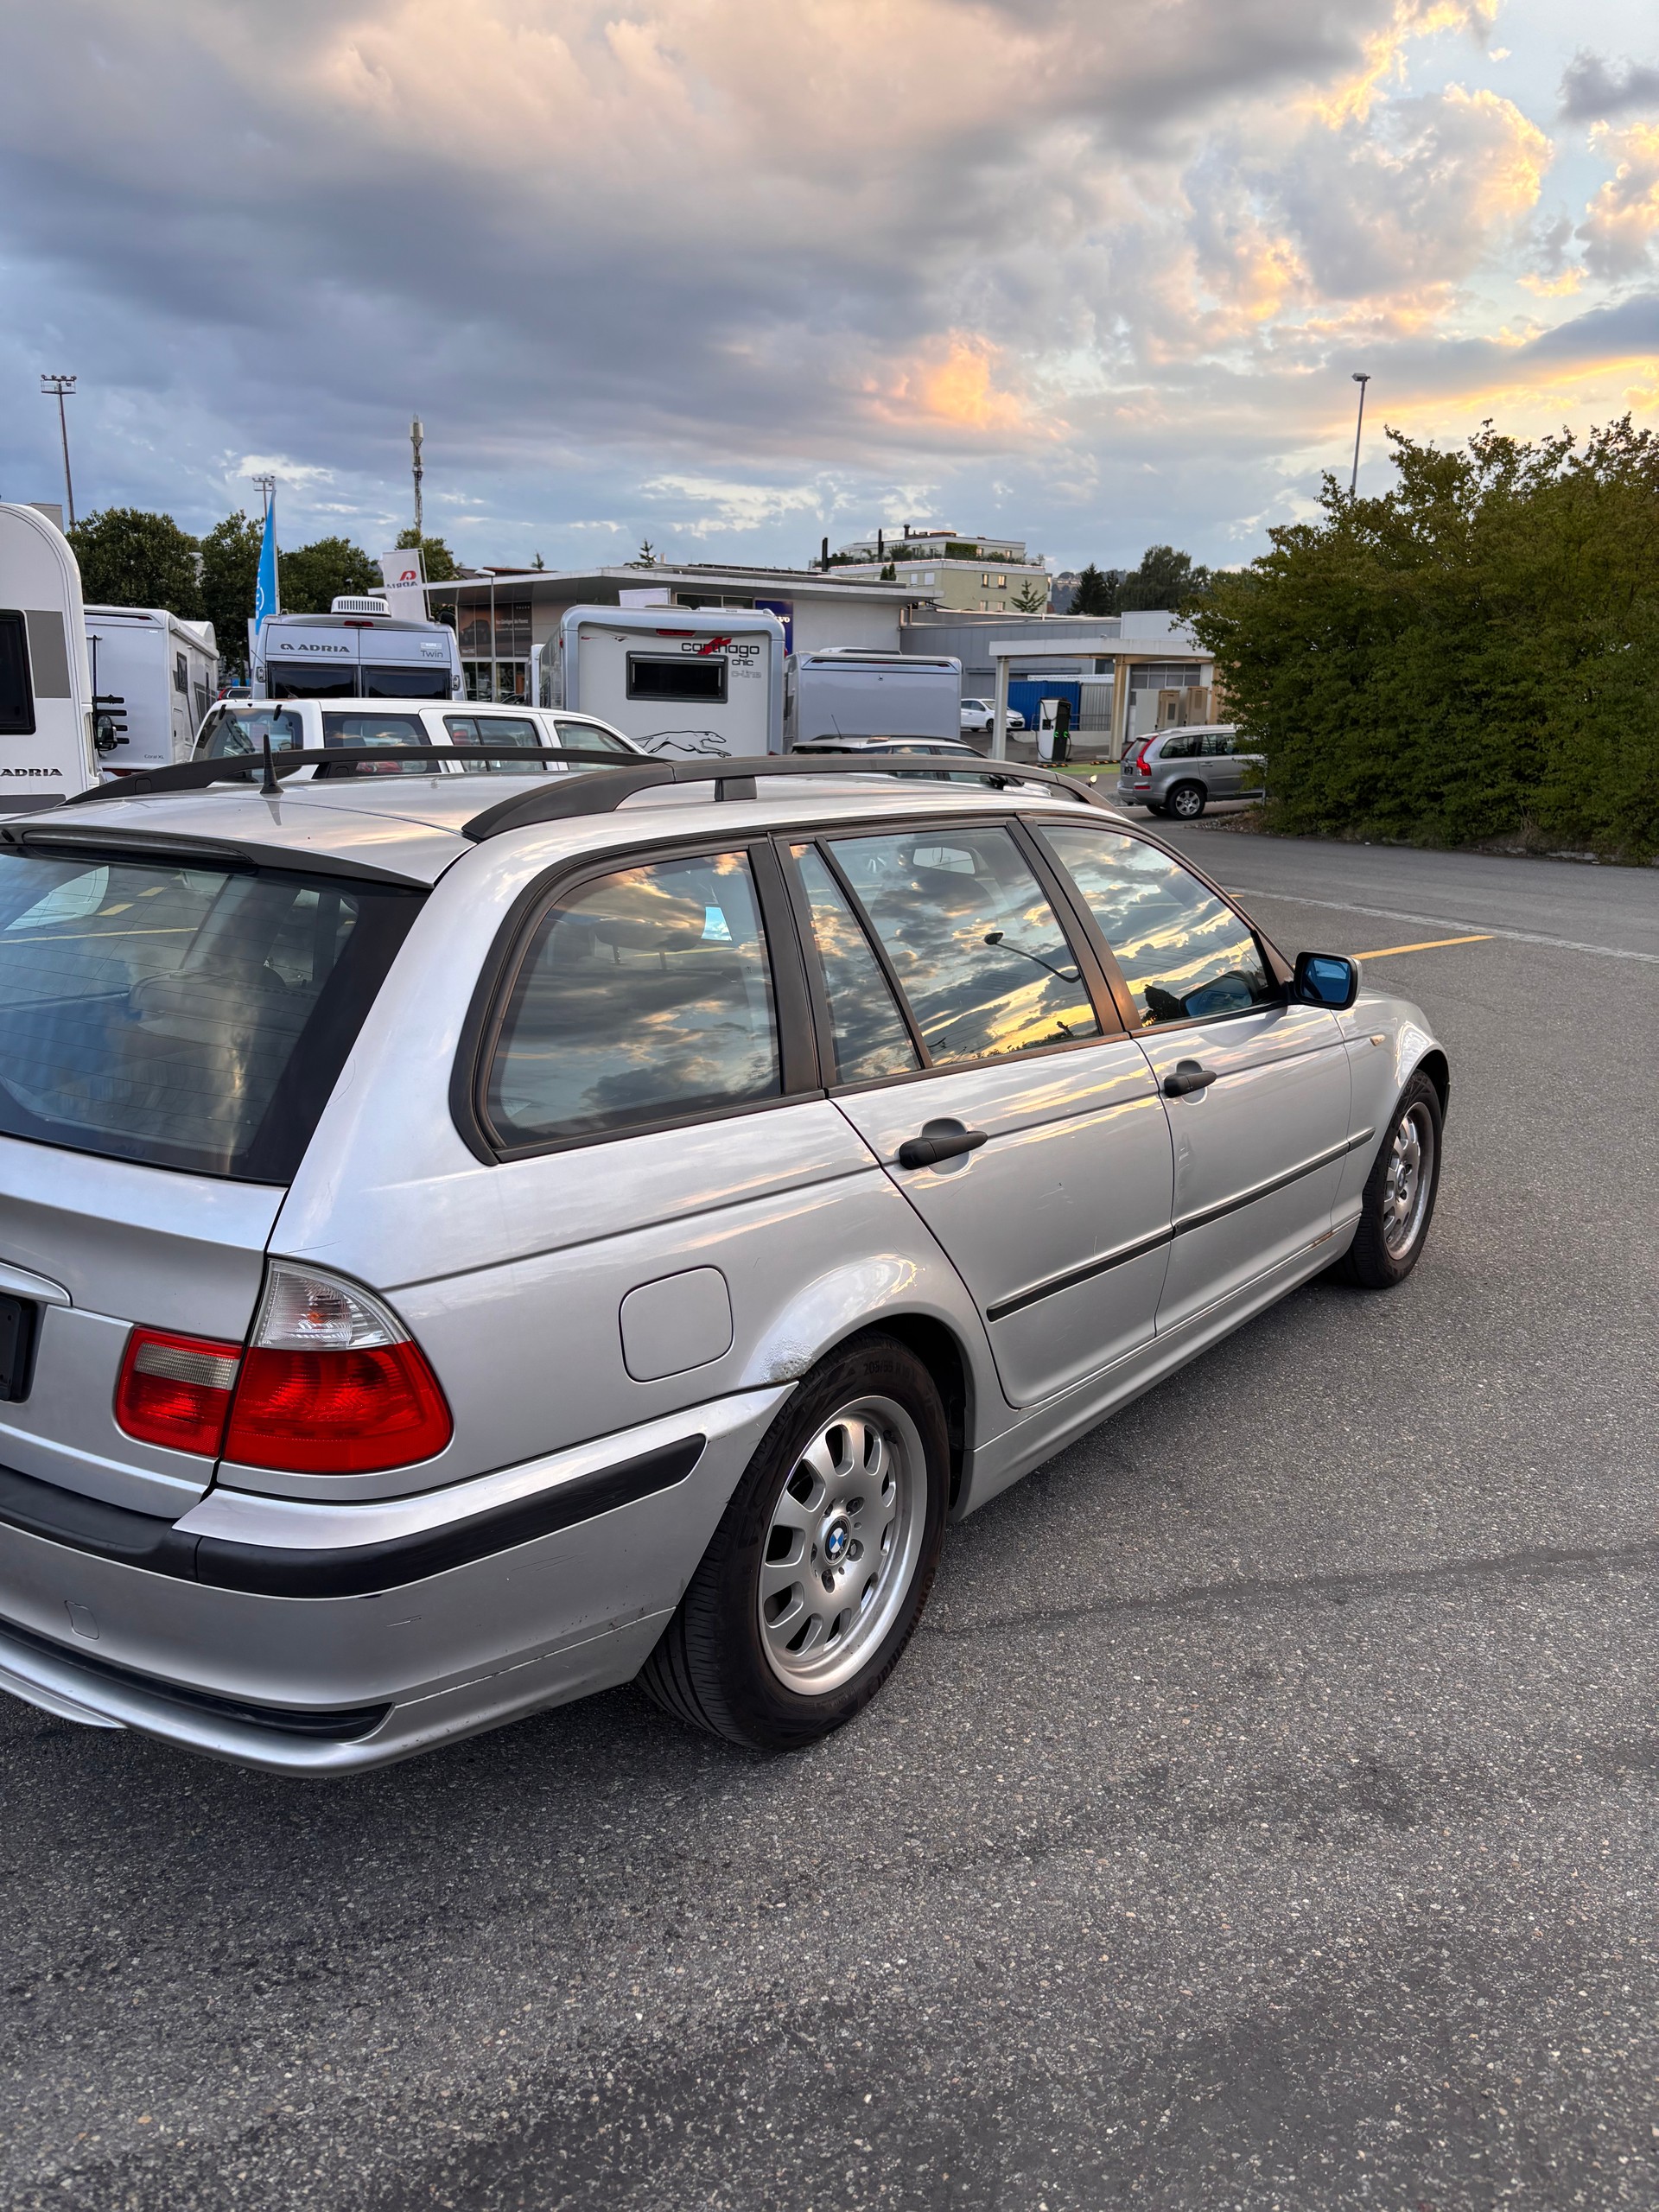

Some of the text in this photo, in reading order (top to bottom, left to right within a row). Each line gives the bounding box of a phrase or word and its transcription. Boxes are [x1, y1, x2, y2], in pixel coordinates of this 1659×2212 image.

[297, 643, 350, 652] ADRIA
[681, 642, 760, 658] carthago
[0, 768, 63, 777] ADRIA
